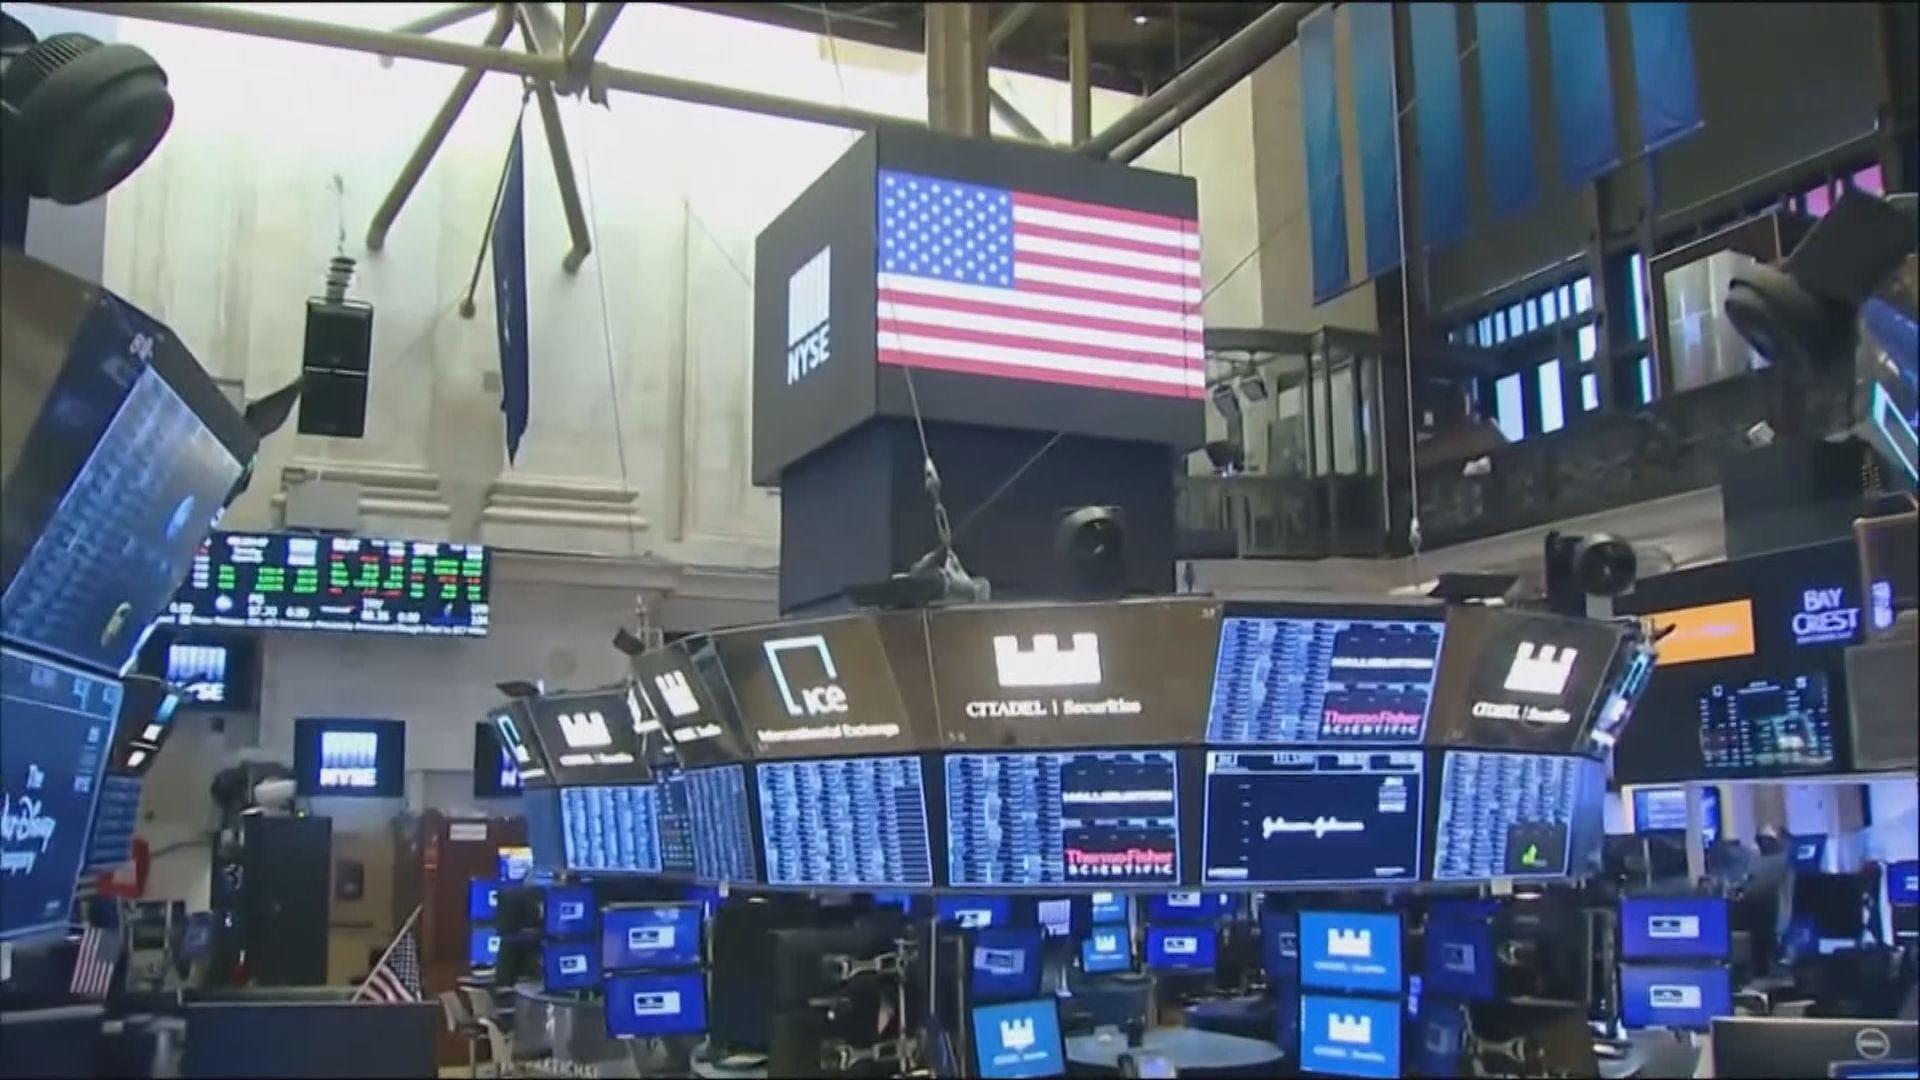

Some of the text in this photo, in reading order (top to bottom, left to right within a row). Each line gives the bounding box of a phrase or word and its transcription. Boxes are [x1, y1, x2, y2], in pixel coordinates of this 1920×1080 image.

[788, 324, 830, 385] NYSE
[1803, 588, 1843, 611] BAY
[1792, 608, 1859, 635] CREST
[319, 767, 378, 787] NYSE
